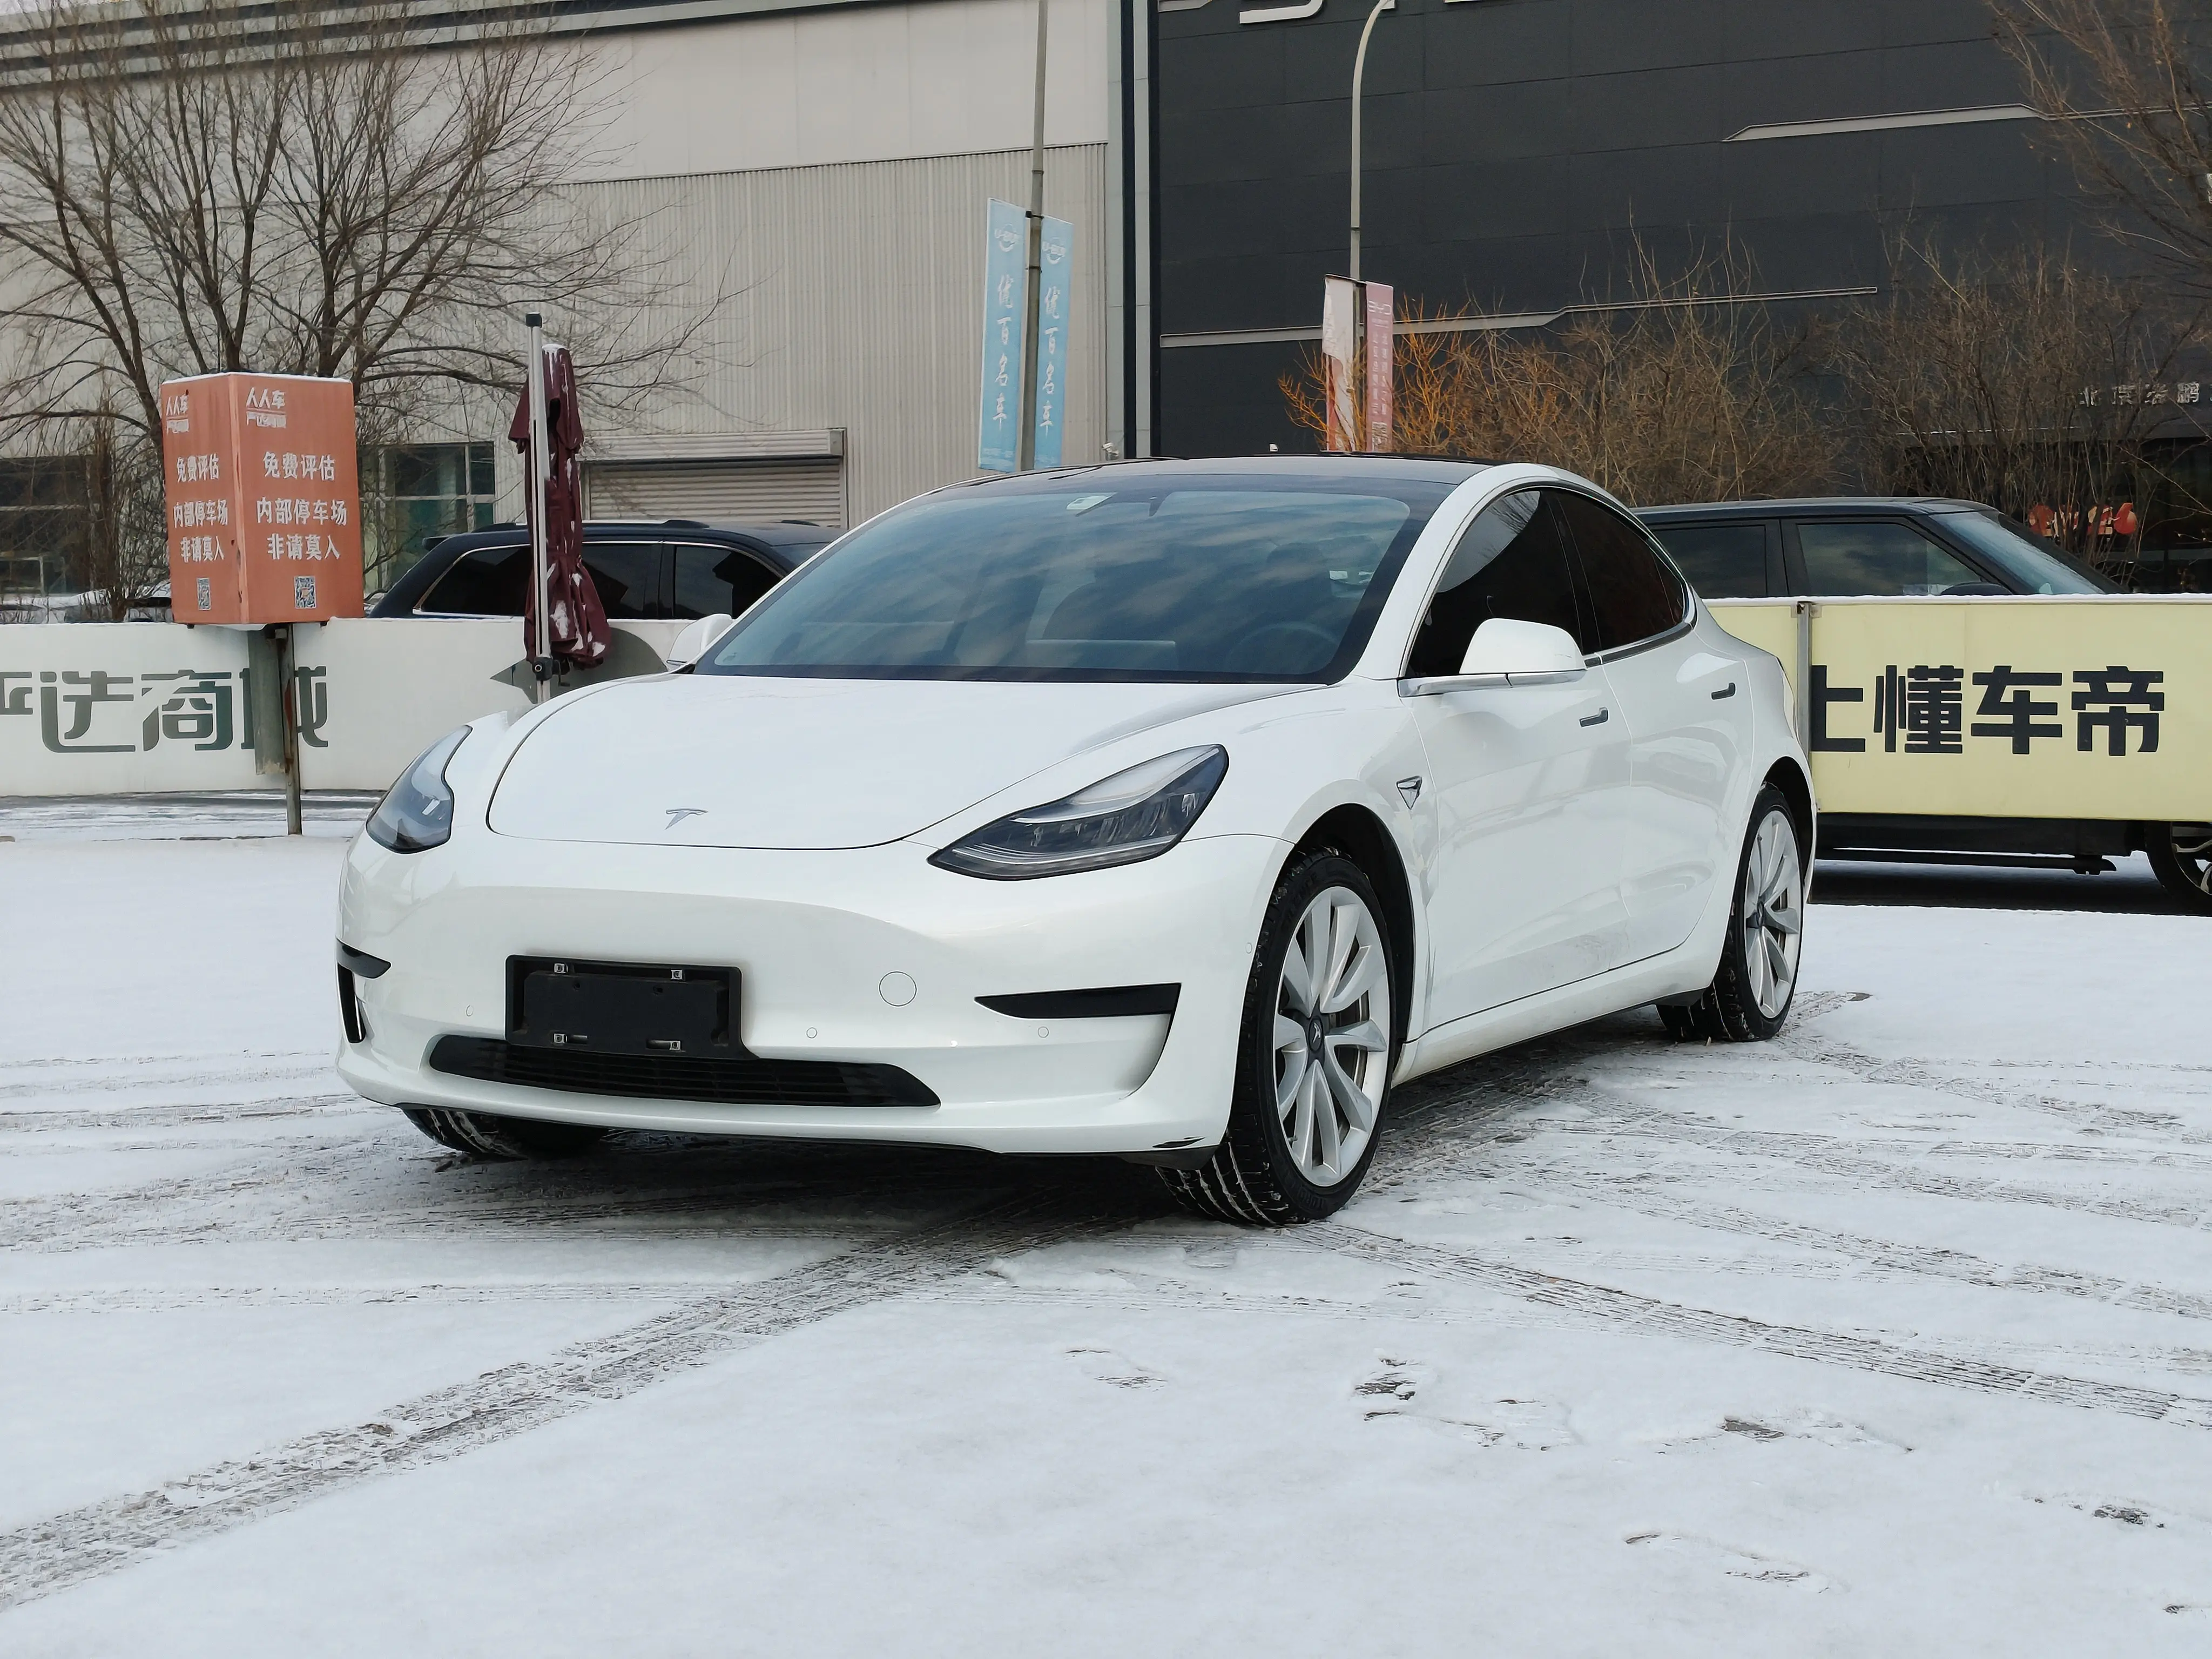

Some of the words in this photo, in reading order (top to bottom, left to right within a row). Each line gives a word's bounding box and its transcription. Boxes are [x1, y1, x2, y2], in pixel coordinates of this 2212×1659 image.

[246, 387, 286, 409] 人人车
[177, 453, 219, 483] 免费评估
[263, 451, 335, 481] 免费评估
[173, 499, 228, 528] 内部停车场
[257, 497, 347, 526] 内部停车场
[180, 536, 224, 563] 非请莫入
[267, 533, 341, 561] 非请莫入
[1812, 664, 2165, 757] 上懂车帝
